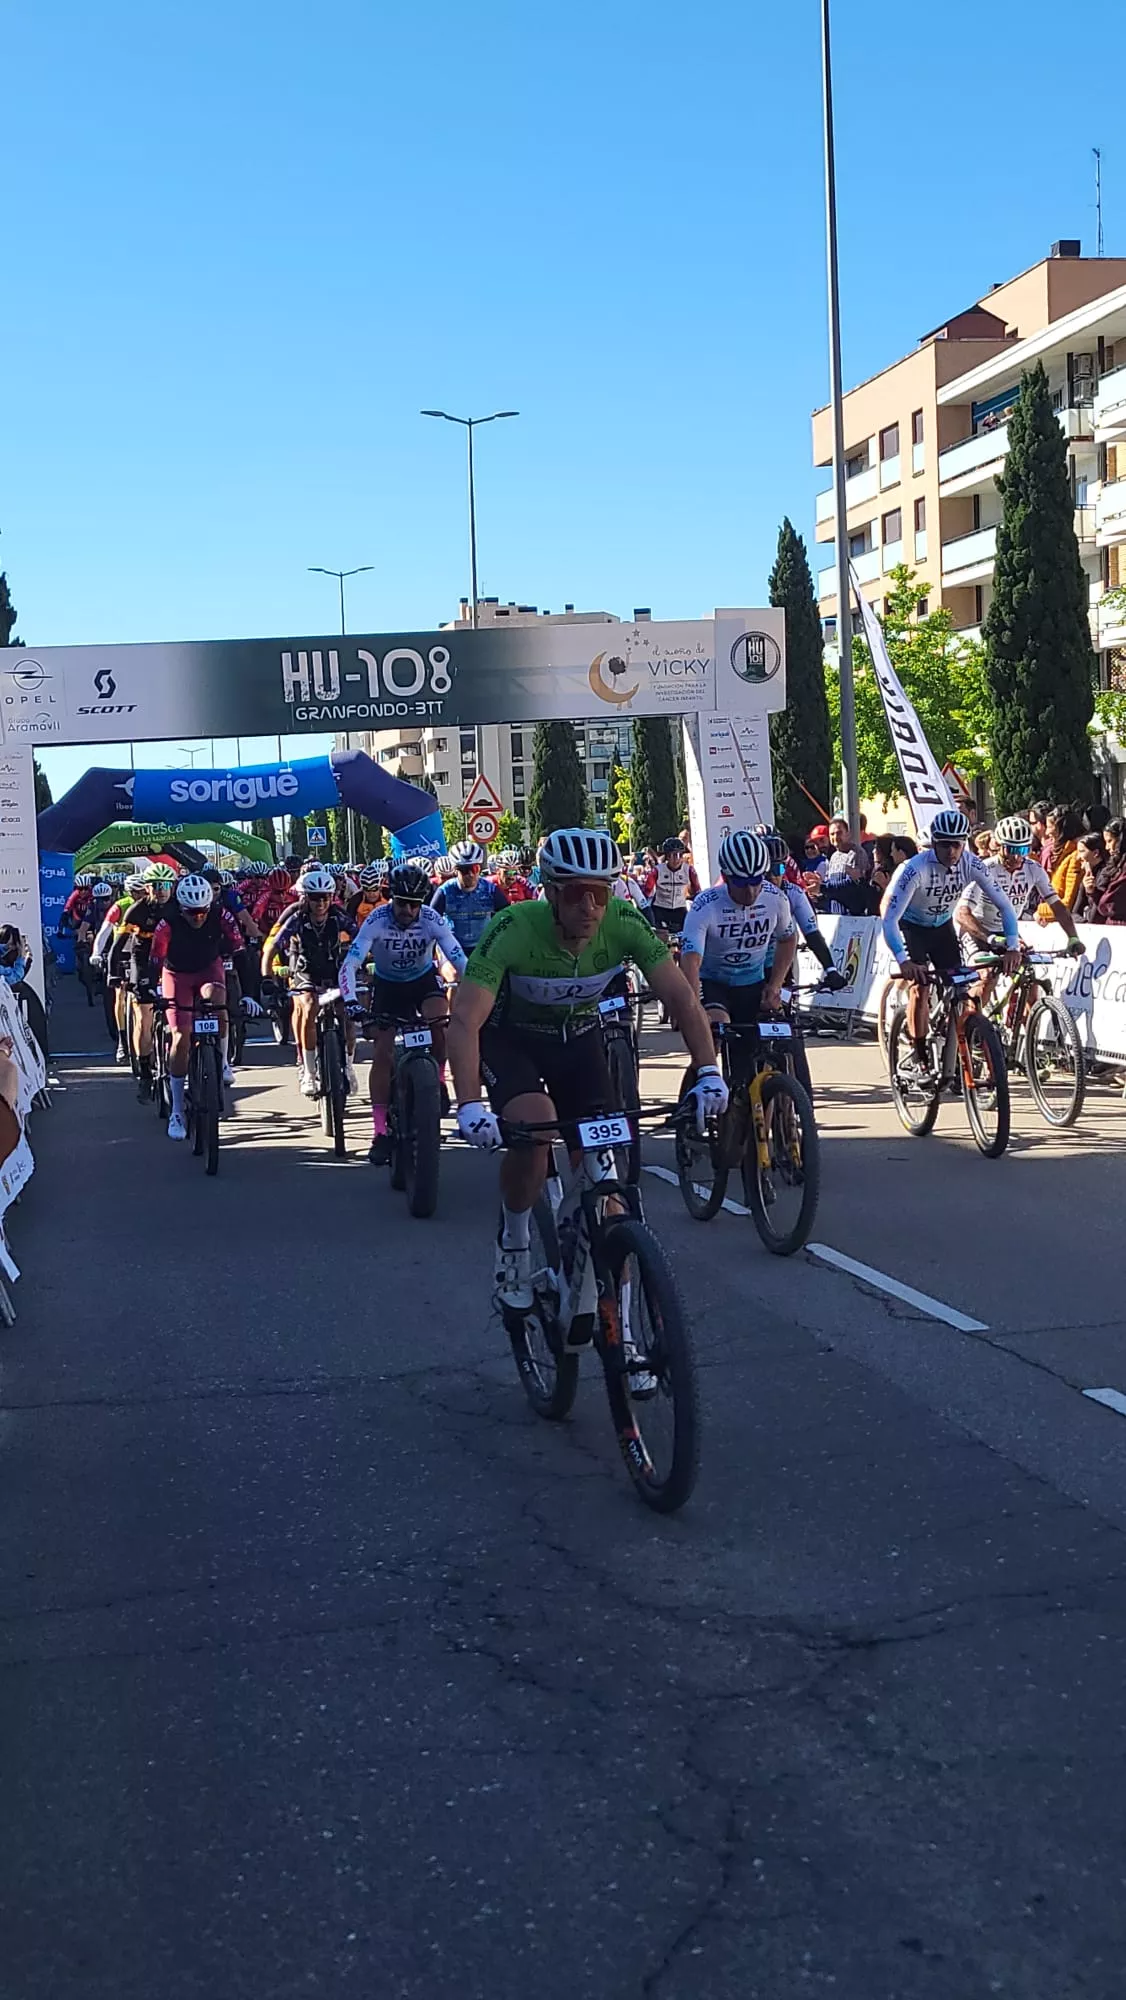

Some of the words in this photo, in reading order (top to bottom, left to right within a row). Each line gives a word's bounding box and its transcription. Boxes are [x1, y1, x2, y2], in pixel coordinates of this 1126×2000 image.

[748, 640, 763, 655] HU
[5, 695, 57, 705] OPEL
[76, 704, 138, 715] SCOTT
[475, 822, 493, 833] 20
[925, 883, 963, 898] TEAM
[718, 918, 770, 938] TEAM
[384, 938, 427, 951] TEAM
[736, 933, 769, 950] 108
[198, 1021, 216, 1031] 108
[771, 1024, 780, 1033] 6
[411, 1033, 425, 1044] 10
[588, 1122, 623, 1140] 395
